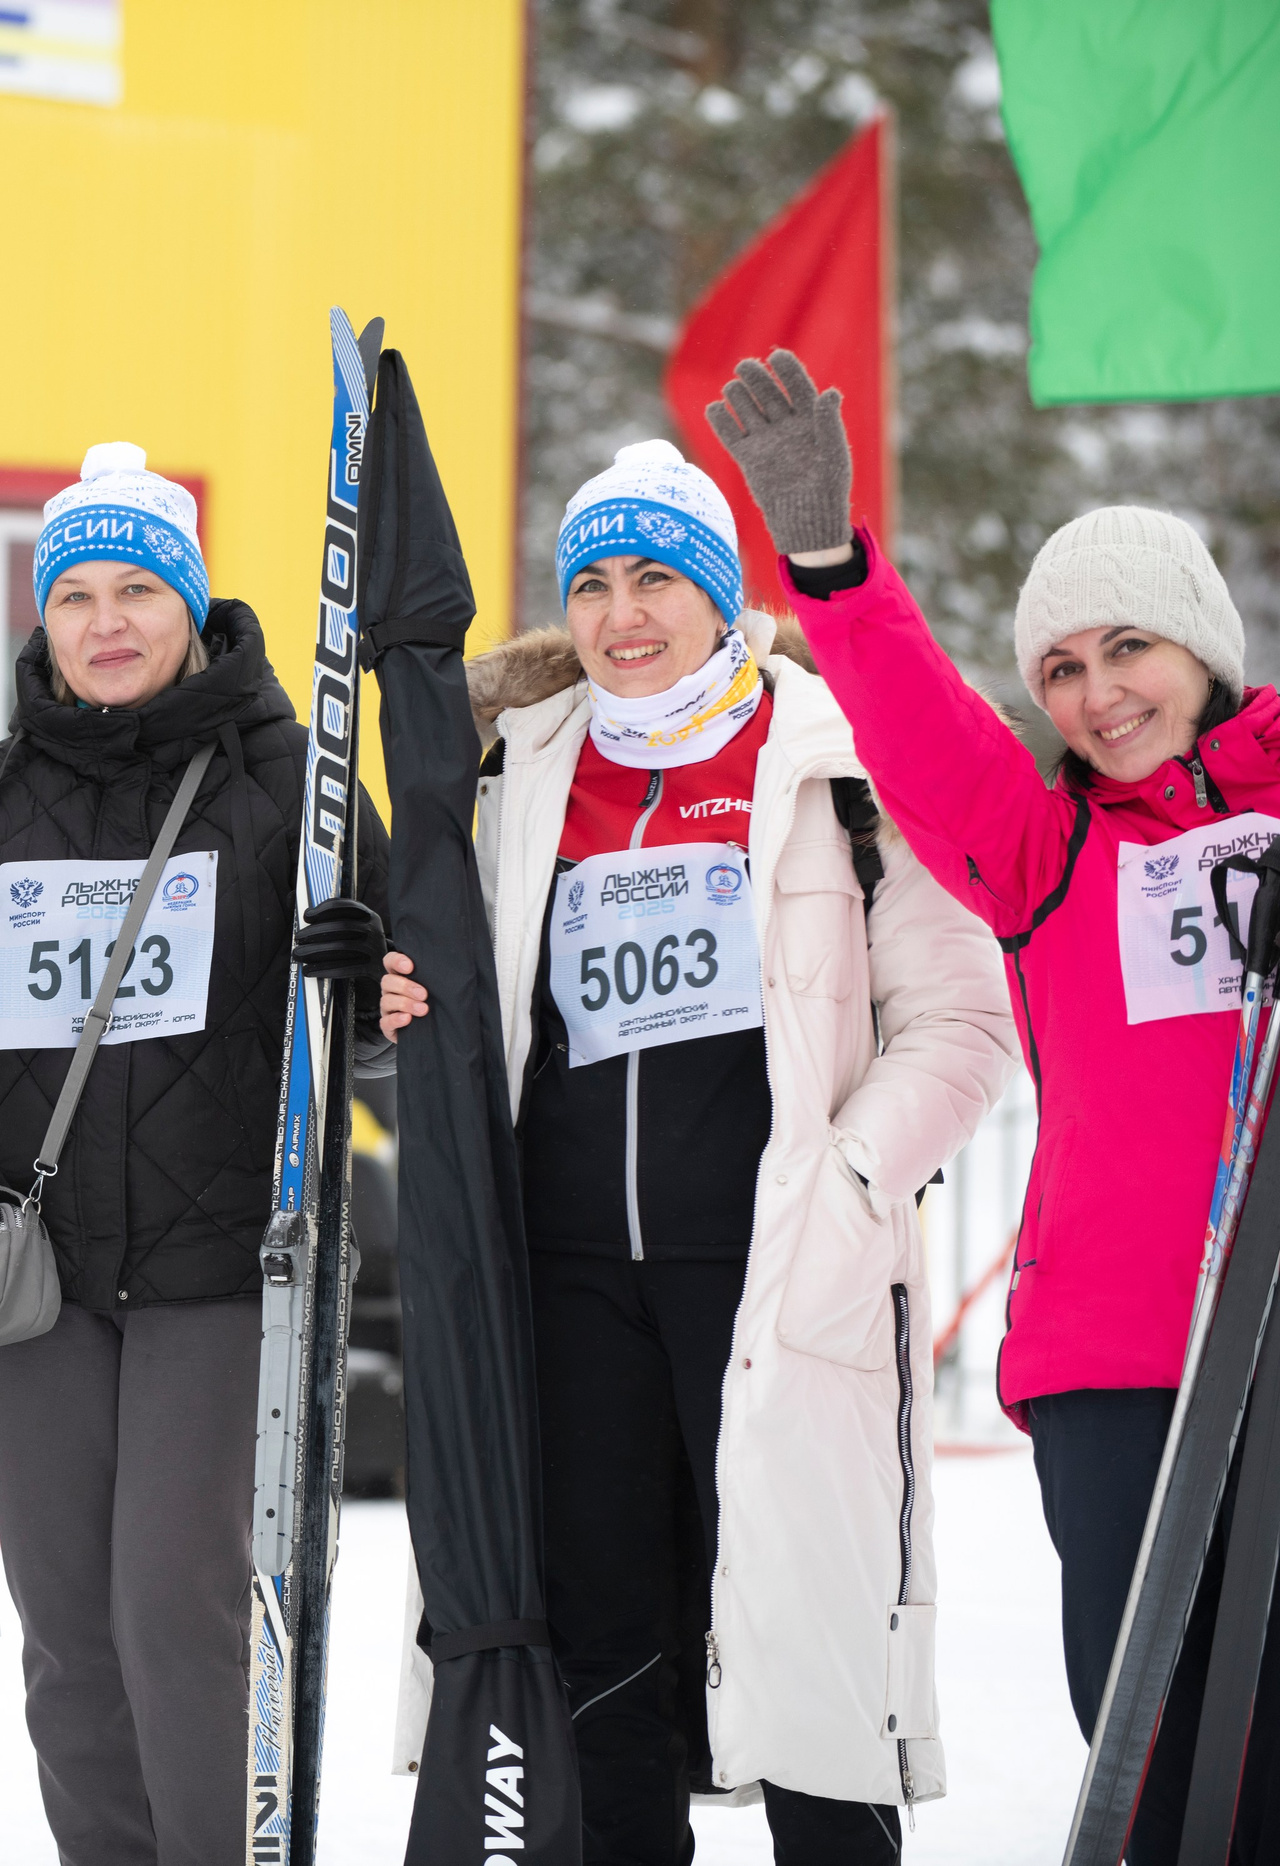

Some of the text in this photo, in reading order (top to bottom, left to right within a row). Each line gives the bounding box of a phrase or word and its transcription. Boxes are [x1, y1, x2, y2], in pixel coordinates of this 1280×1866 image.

[346, 412, 363, 485] OMNI
[312, 448, 357, 851] motor
[679, 798, 754, 818] VITZHE
[603, 865, 686, 890] ЛЫЖНЯ
[1141, 879, 1183, 892] МИНСПОРТ
[61, 892, 134, 907] РОССИ
[600, 880, 689, 906] РОССИИ
[1146, 887, 1178, 898] РОССИИ
[9, 911, 46, 922] МИНСПОРТ
[618, 897, 676, 920] 2025
[13, 919, 41, 929] РОССИИ
[564, 924, 585, 935] РОССИИ
[1170, 902, 1242, 966] 51
[27, 934, 174, 1001] 5123
[289, 963, 298, 997] CORE
[580, 928, 718, 1012] 5063
[135, 1019, 161, 1028] ОКРУГ
[172, 1013, 196, 1023] ЮГРА
[285, 1002, 295, 1036] WOOD
[618, 1018, 677, 1037] АВТОНОМНЫЙ
[680, 1012, 709, 1025] ОКРУГ
[721, 1006, 749, 1017] ЮГРА
[619, 1002, 709, 1029] ХАНТЫ-МАНСИЙСКИЙ
[280, 1044, 292, 1099] CHANNEL
[279, 1103, 287, 1122] AIR
[292, 1113, 302, 1151] AIRMIX
[288, 1186, 296, 1210] CAP
[261, 1639, 283, 1751] Universal
